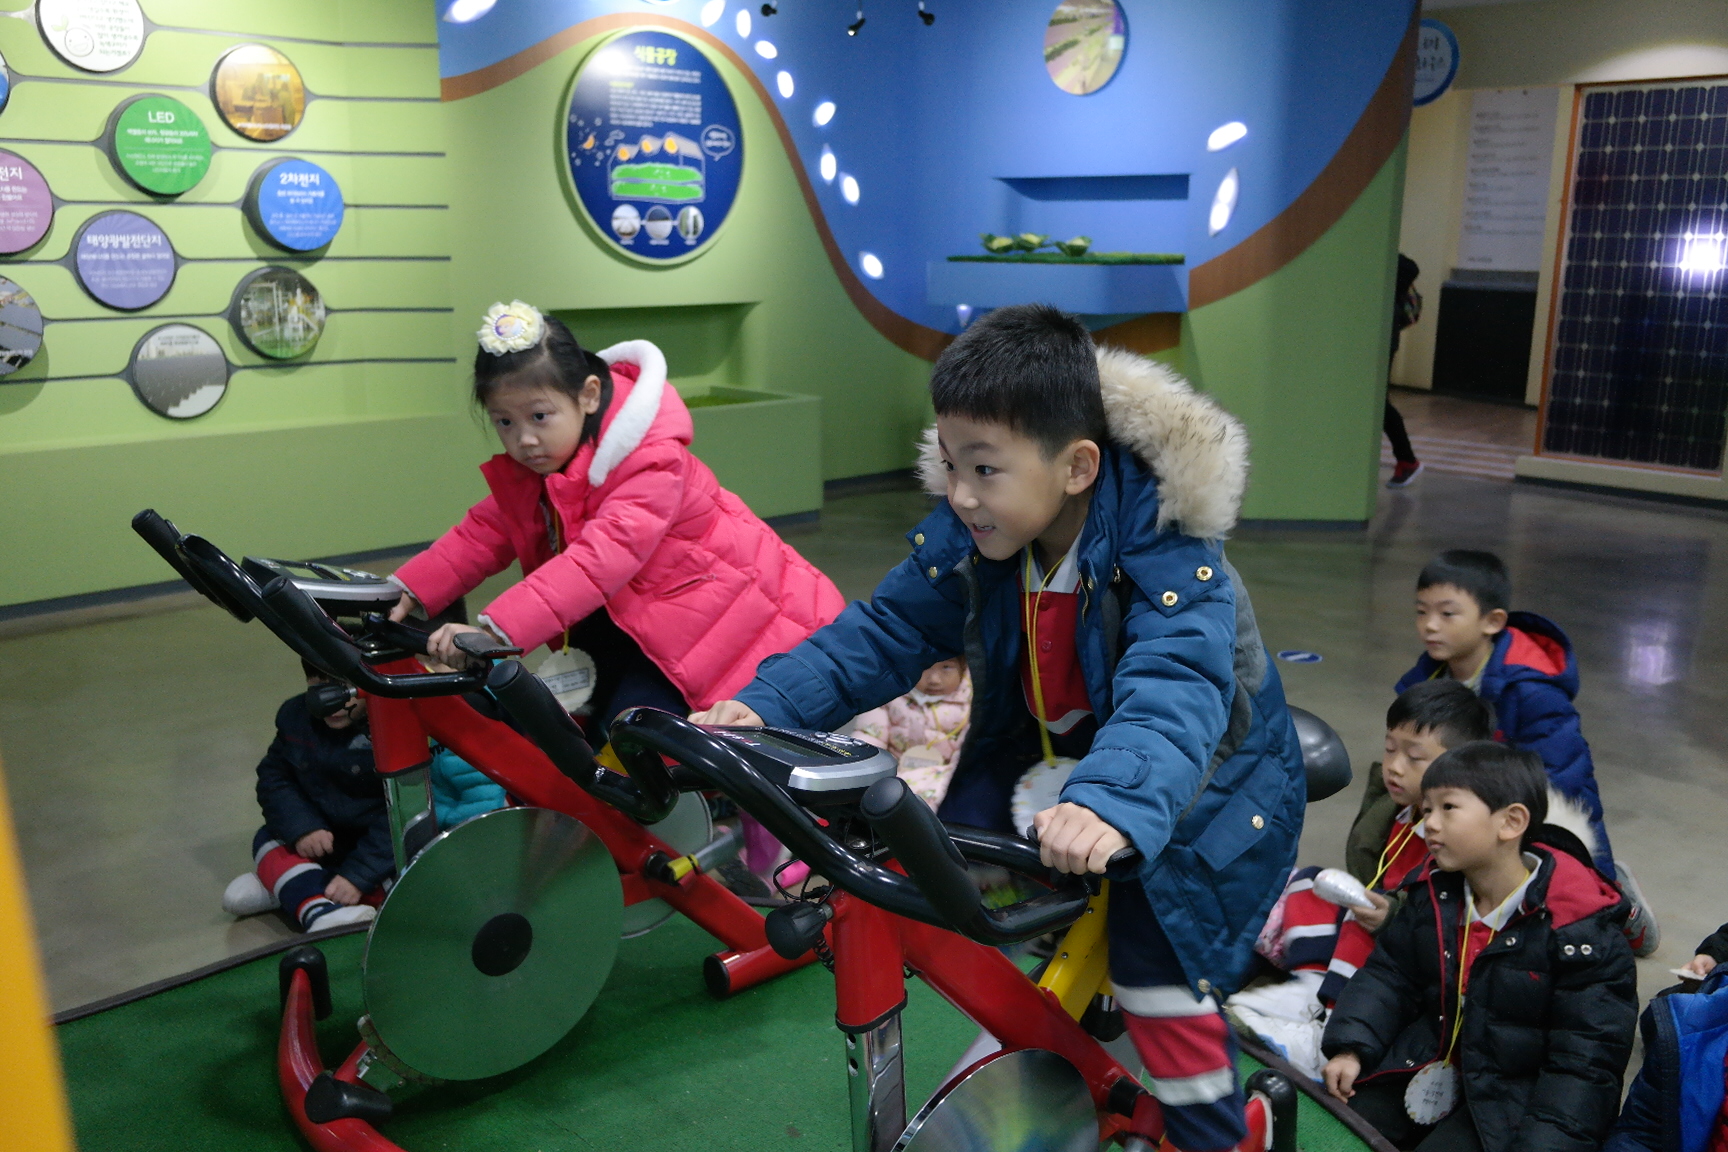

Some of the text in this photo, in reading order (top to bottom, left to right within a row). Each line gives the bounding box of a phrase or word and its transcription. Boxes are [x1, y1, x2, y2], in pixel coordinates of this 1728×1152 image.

[147, 110, 175, 124] LED
[279, 172, 320, 188] 2차전지
[86, 233, 162, 249] 태양광발전단지
